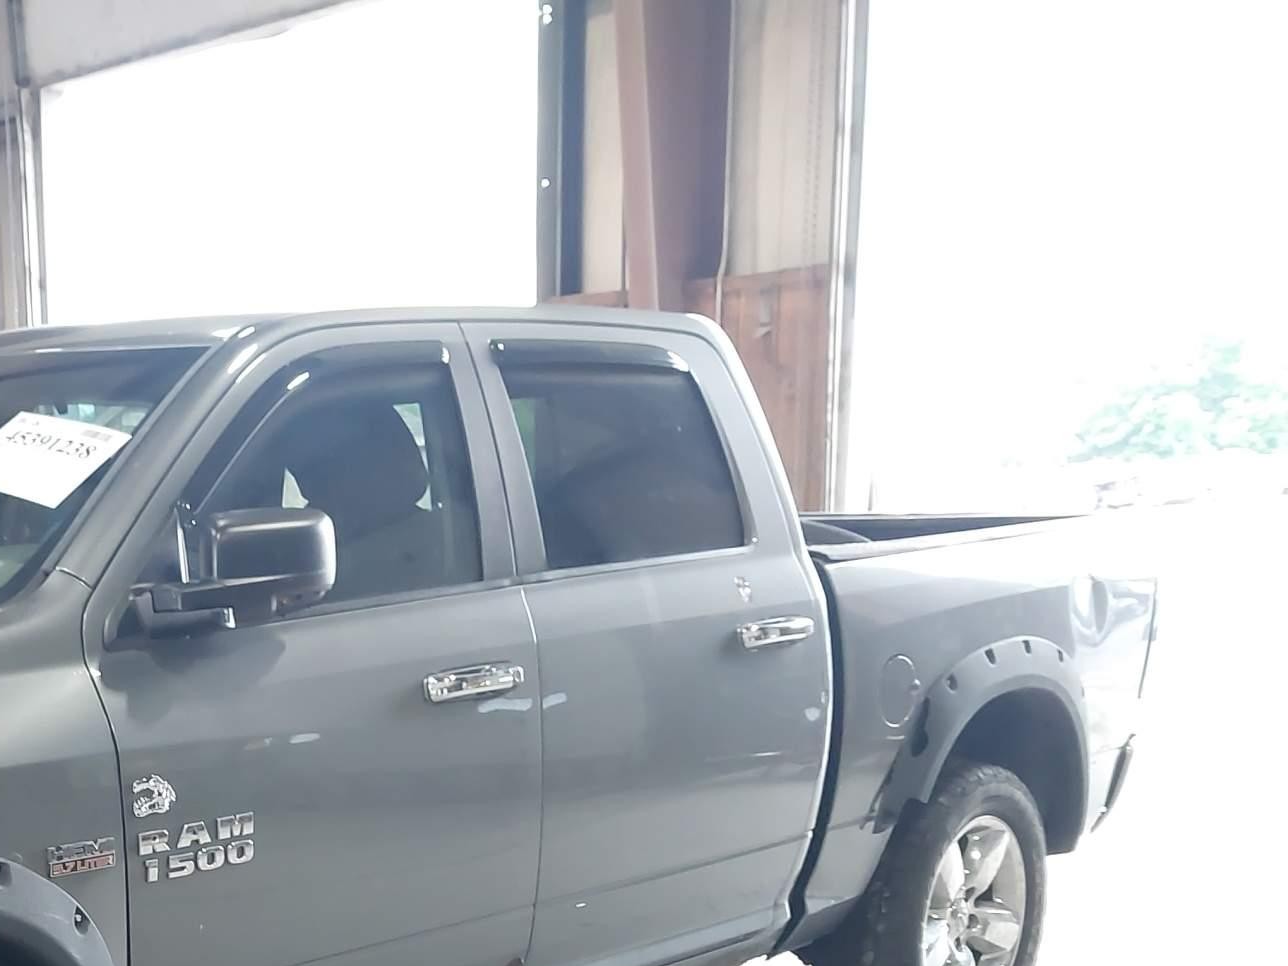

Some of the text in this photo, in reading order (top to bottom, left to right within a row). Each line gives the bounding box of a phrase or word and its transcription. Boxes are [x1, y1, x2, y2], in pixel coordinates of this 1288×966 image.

[6, 430, 97, 459] 45391238
[138, 811, 255, 856] RAM
[145, 839, 255, 883] 1500
